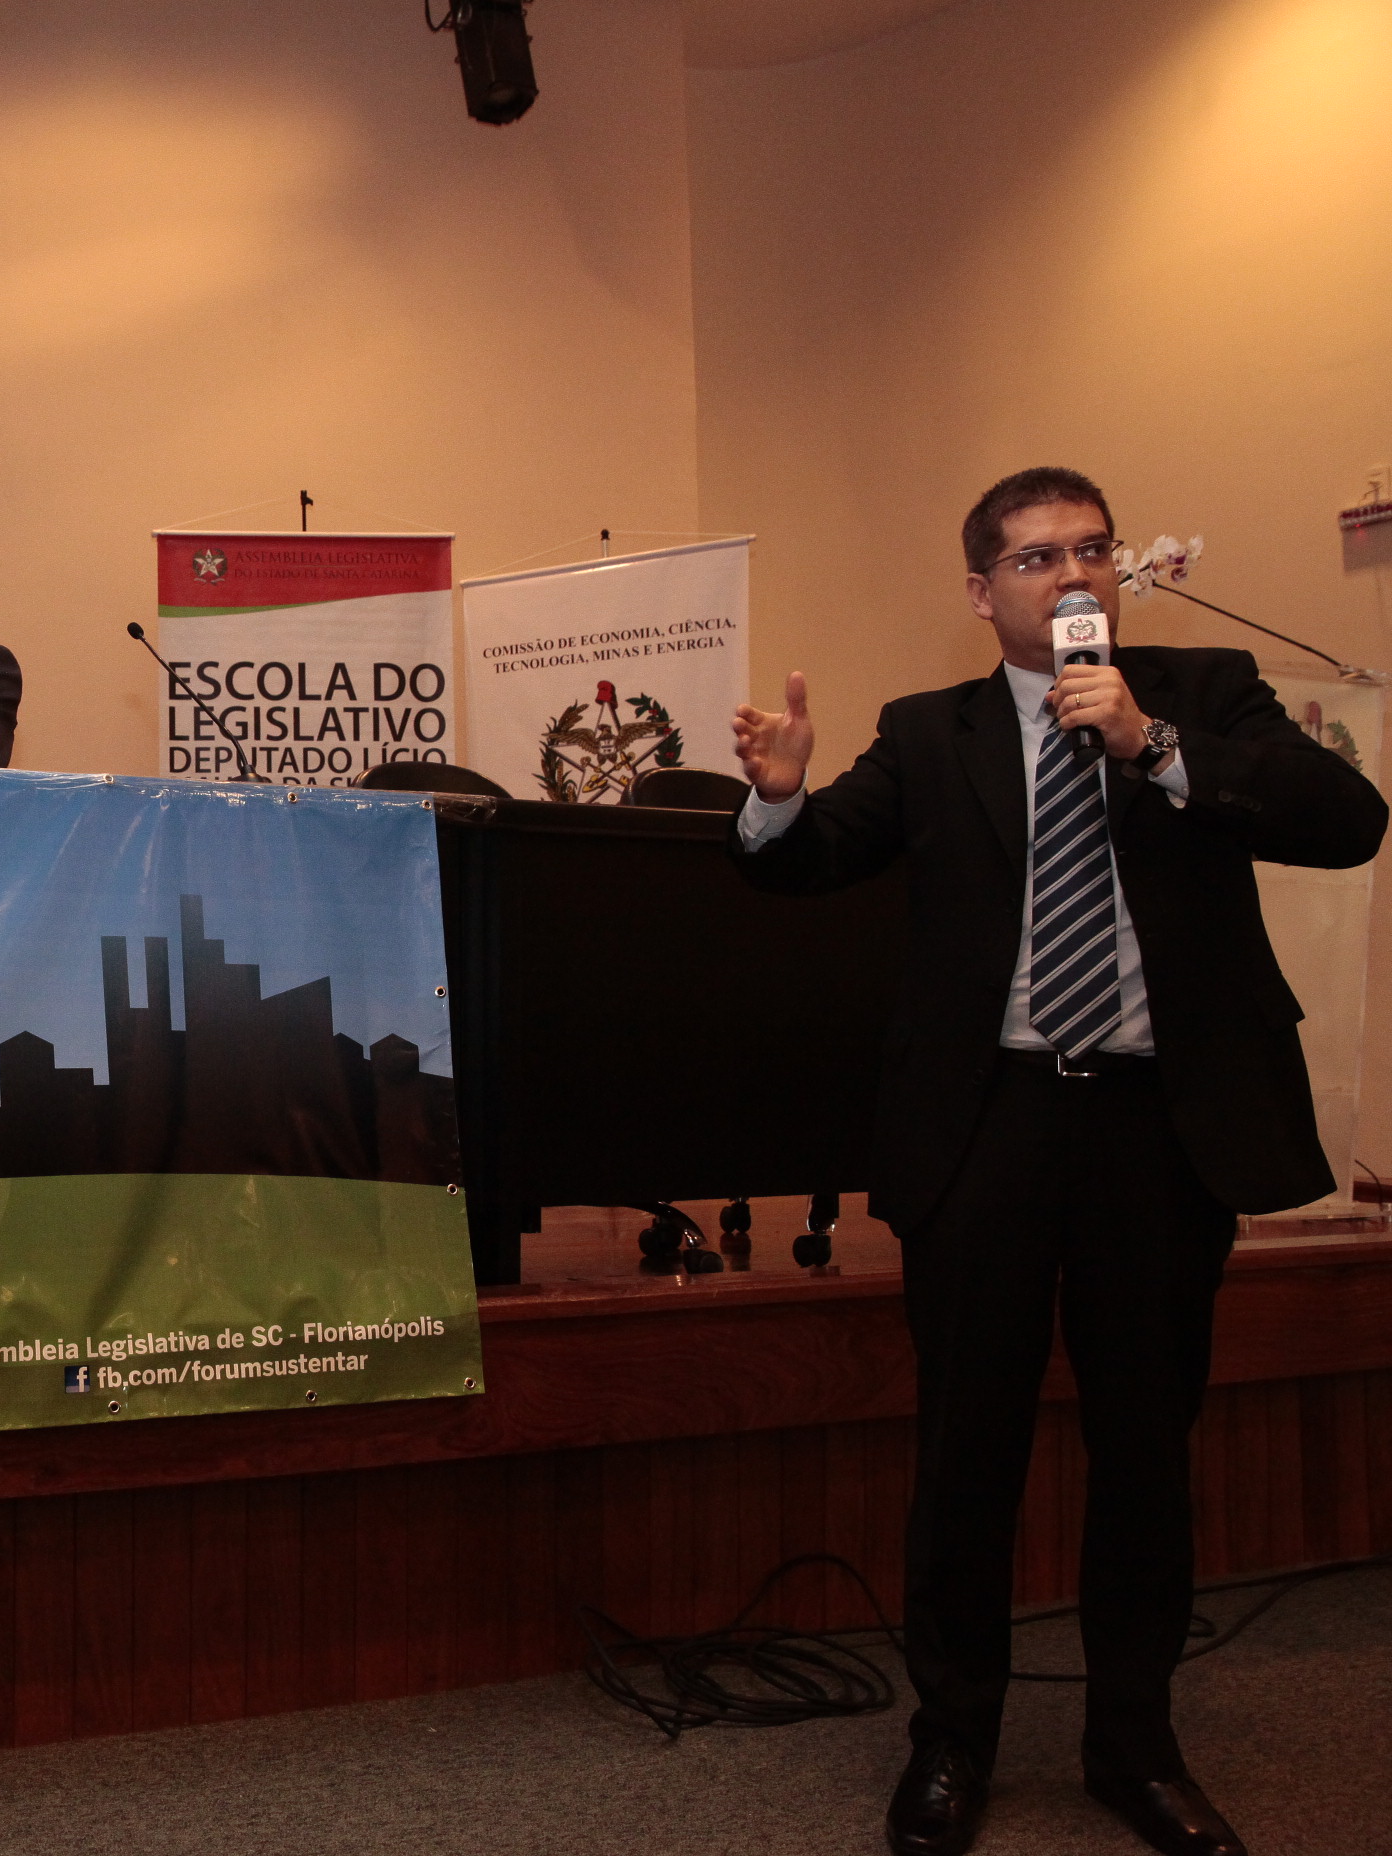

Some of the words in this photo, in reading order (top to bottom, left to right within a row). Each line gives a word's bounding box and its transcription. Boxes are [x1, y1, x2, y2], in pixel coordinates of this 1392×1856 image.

[483, 638, 554, 659] COMISSÃO
[558, 637, 576, 649] DE
[581, 627, 665, 646] ECONOMIA,
[669, 617, 736, 635] CIÊNCIA,
[493, 652, 589, 674] TECNOLOGIA,
[593, 646, 639, 662] MINAS
[644, 644, 653, 656] E
[657, 636, 725, 654] ENERGIA
[168, 661, 358, 702] ESCOLA
[373, 662, 446, 703] DO
[168, 706, 447, 743] LEGISLATIVO
[169, 746, 352, 774] DEPUTADO
[86, 1331, 209, 1361] Legislativa
[216, 1327, 245, 1349] de
[251, 1324, 283, 1347] SC
[303, 1316, 445, 1345] Florianópolis
[97, 1351, 369, 1388] fb.com/forumsustentar
